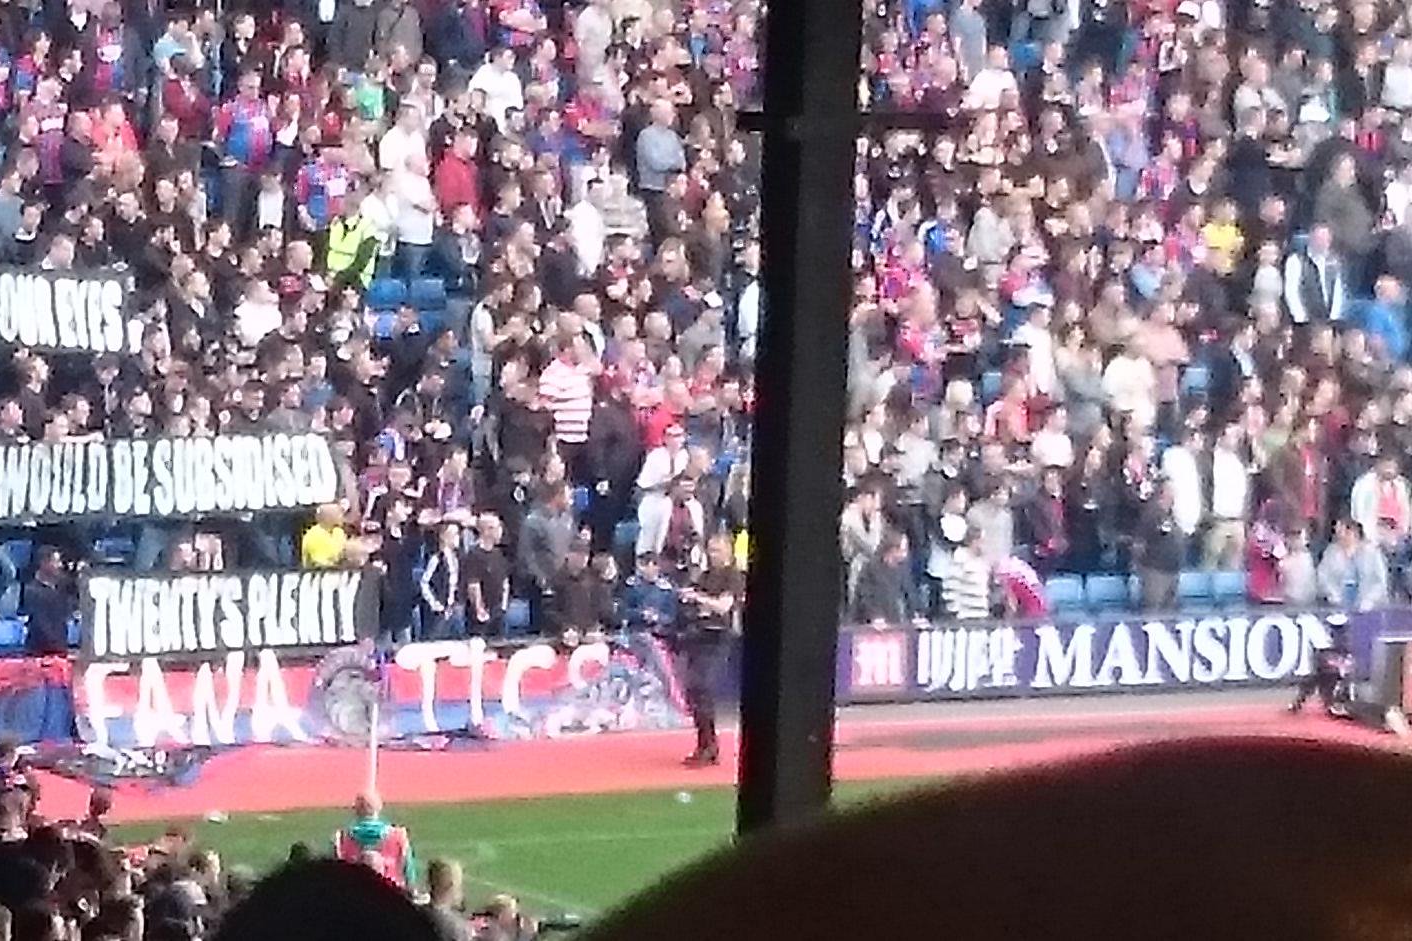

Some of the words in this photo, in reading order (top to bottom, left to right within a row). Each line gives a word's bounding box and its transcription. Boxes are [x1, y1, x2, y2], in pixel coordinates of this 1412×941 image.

[112, 439, 151, 515] BE
[152, 433, 337, 516] SUBSIDISED
[247, 571, 361, 646] PLENTY
